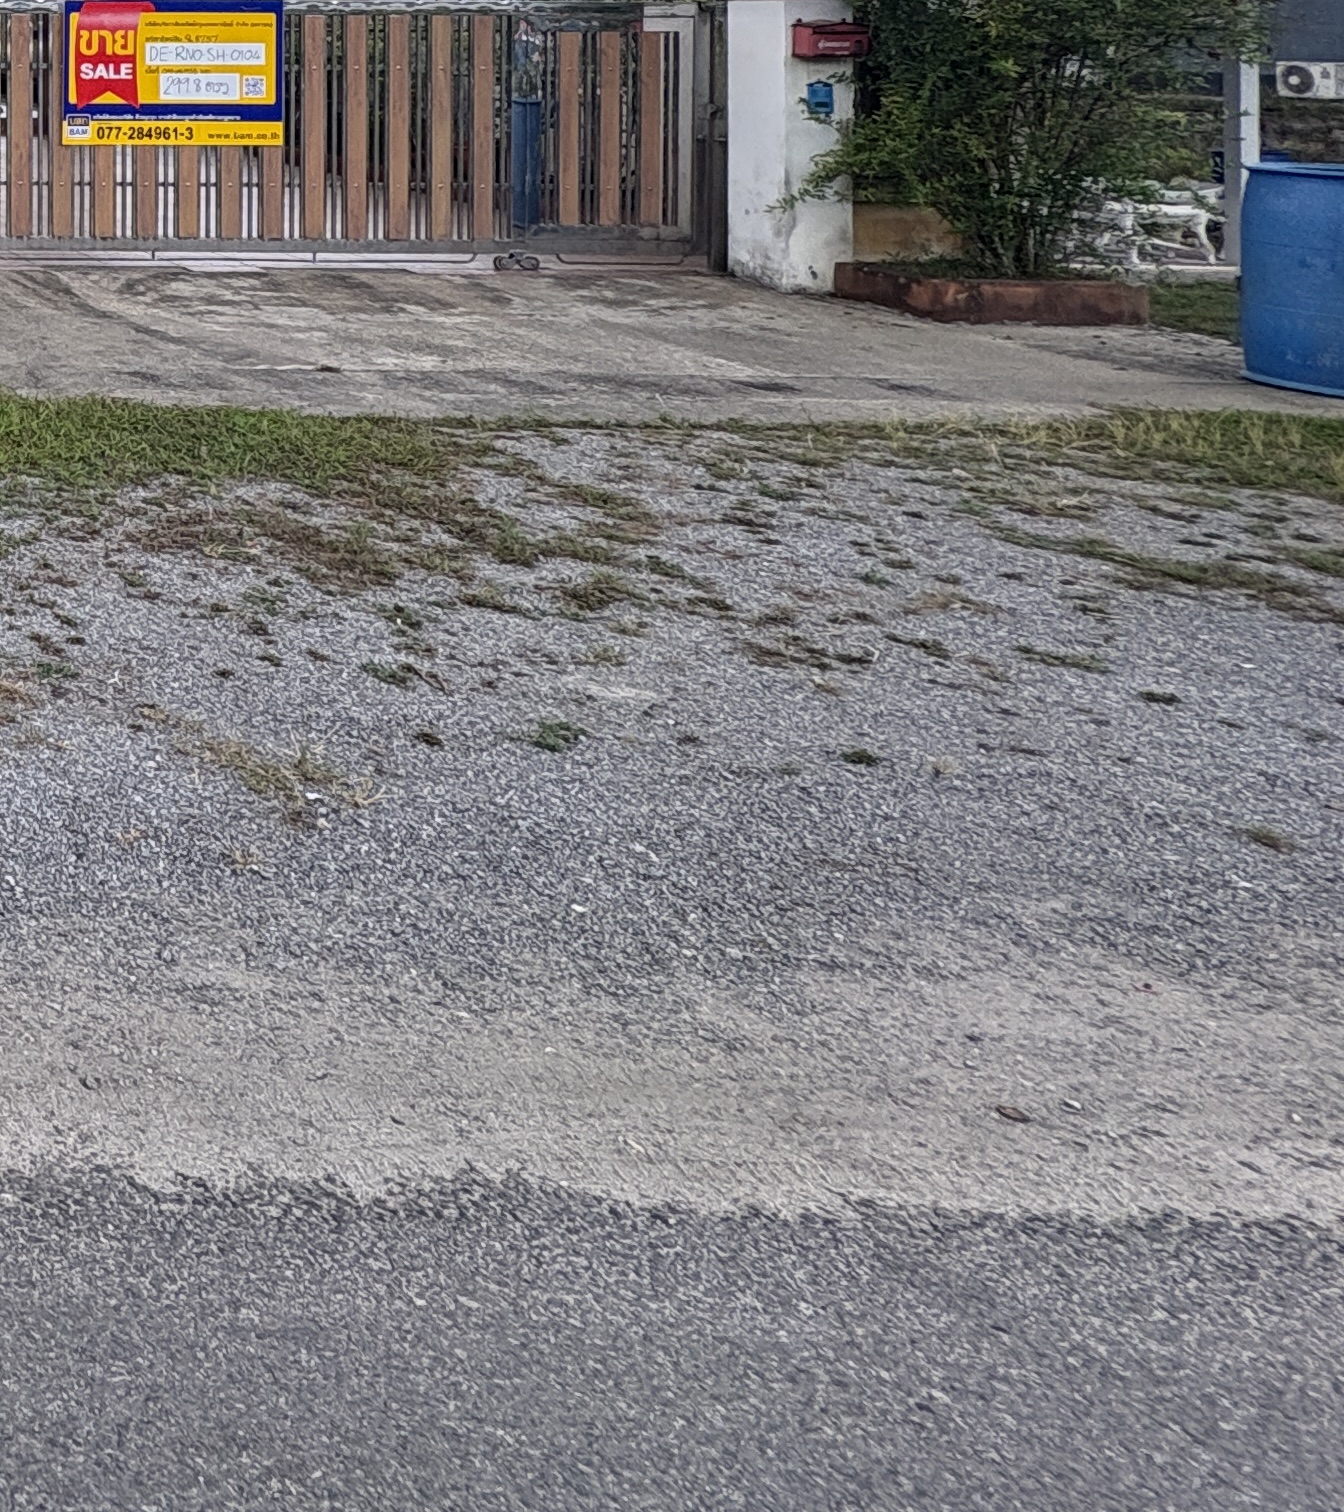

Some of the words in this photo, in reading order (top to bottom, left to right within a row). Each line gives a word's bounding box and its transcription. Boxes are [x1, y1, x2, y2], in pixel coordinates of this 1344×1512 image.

[79, 29, 135, 56] ขาย
[79, 63, 134, 80] SALE
[96, 126, 194, 141] 077-284961-3
